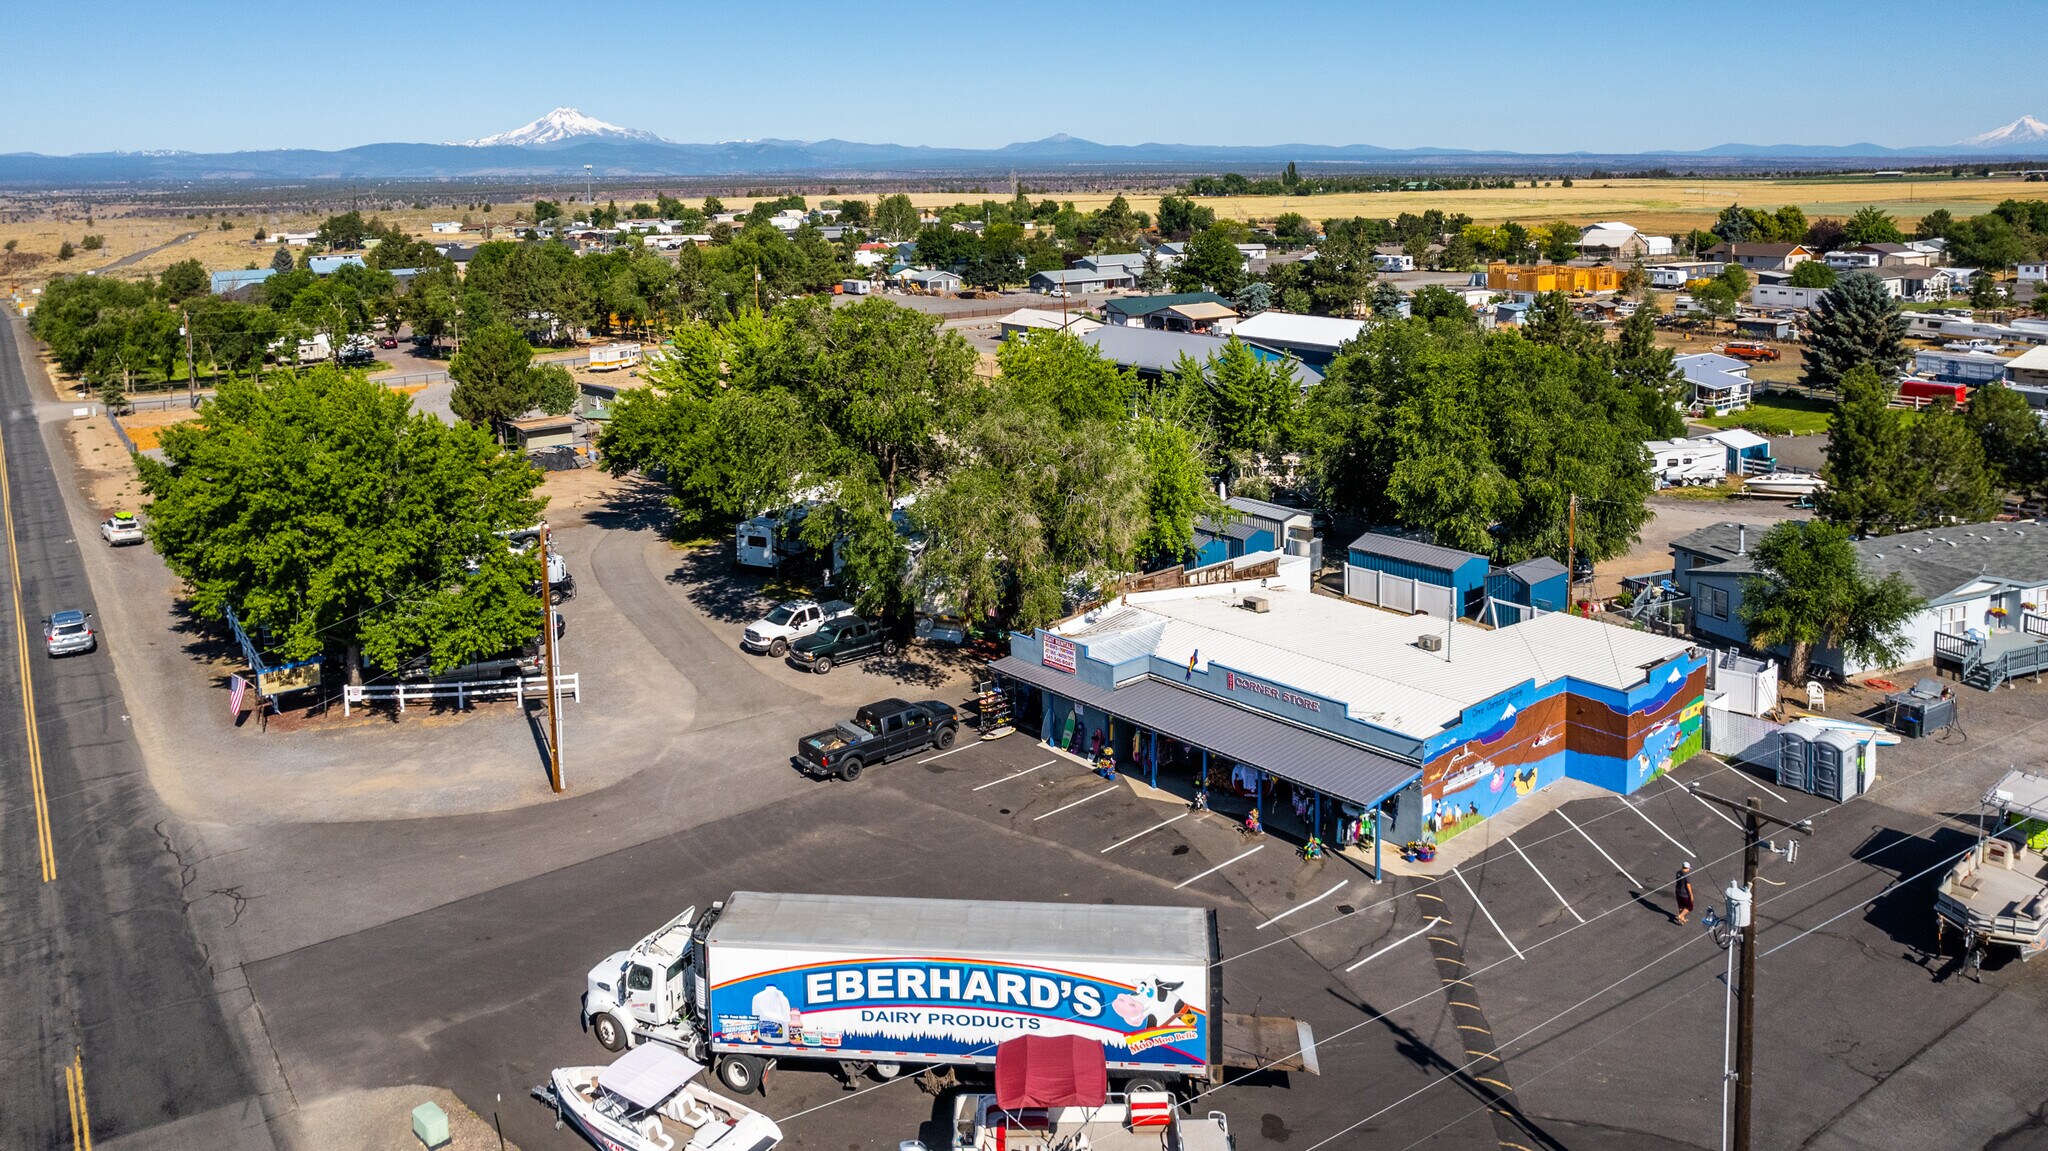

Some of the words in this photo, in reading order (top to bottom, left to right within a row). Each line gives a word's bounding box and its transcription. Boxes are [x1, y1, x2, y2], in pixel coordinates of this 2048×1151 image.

[1235, 677, 1280, 699] CORNER
[1282, 691, 1321, 713] STORE
[1472, 708, 1485, 718] Cove
[1487, 697, 1505, 710] Corner
[1507, 689, 1523, 703] Store
[806, 968, 1103, 1018] EBERHARD'S
[861, 1010, 922, 1024] DAIRY
[928, 1013, 1041, 1030] PRODUCTS
[1154, 1035, 1174, 1045] Moo
[1175, 1032, 1197, 1041] Belle
